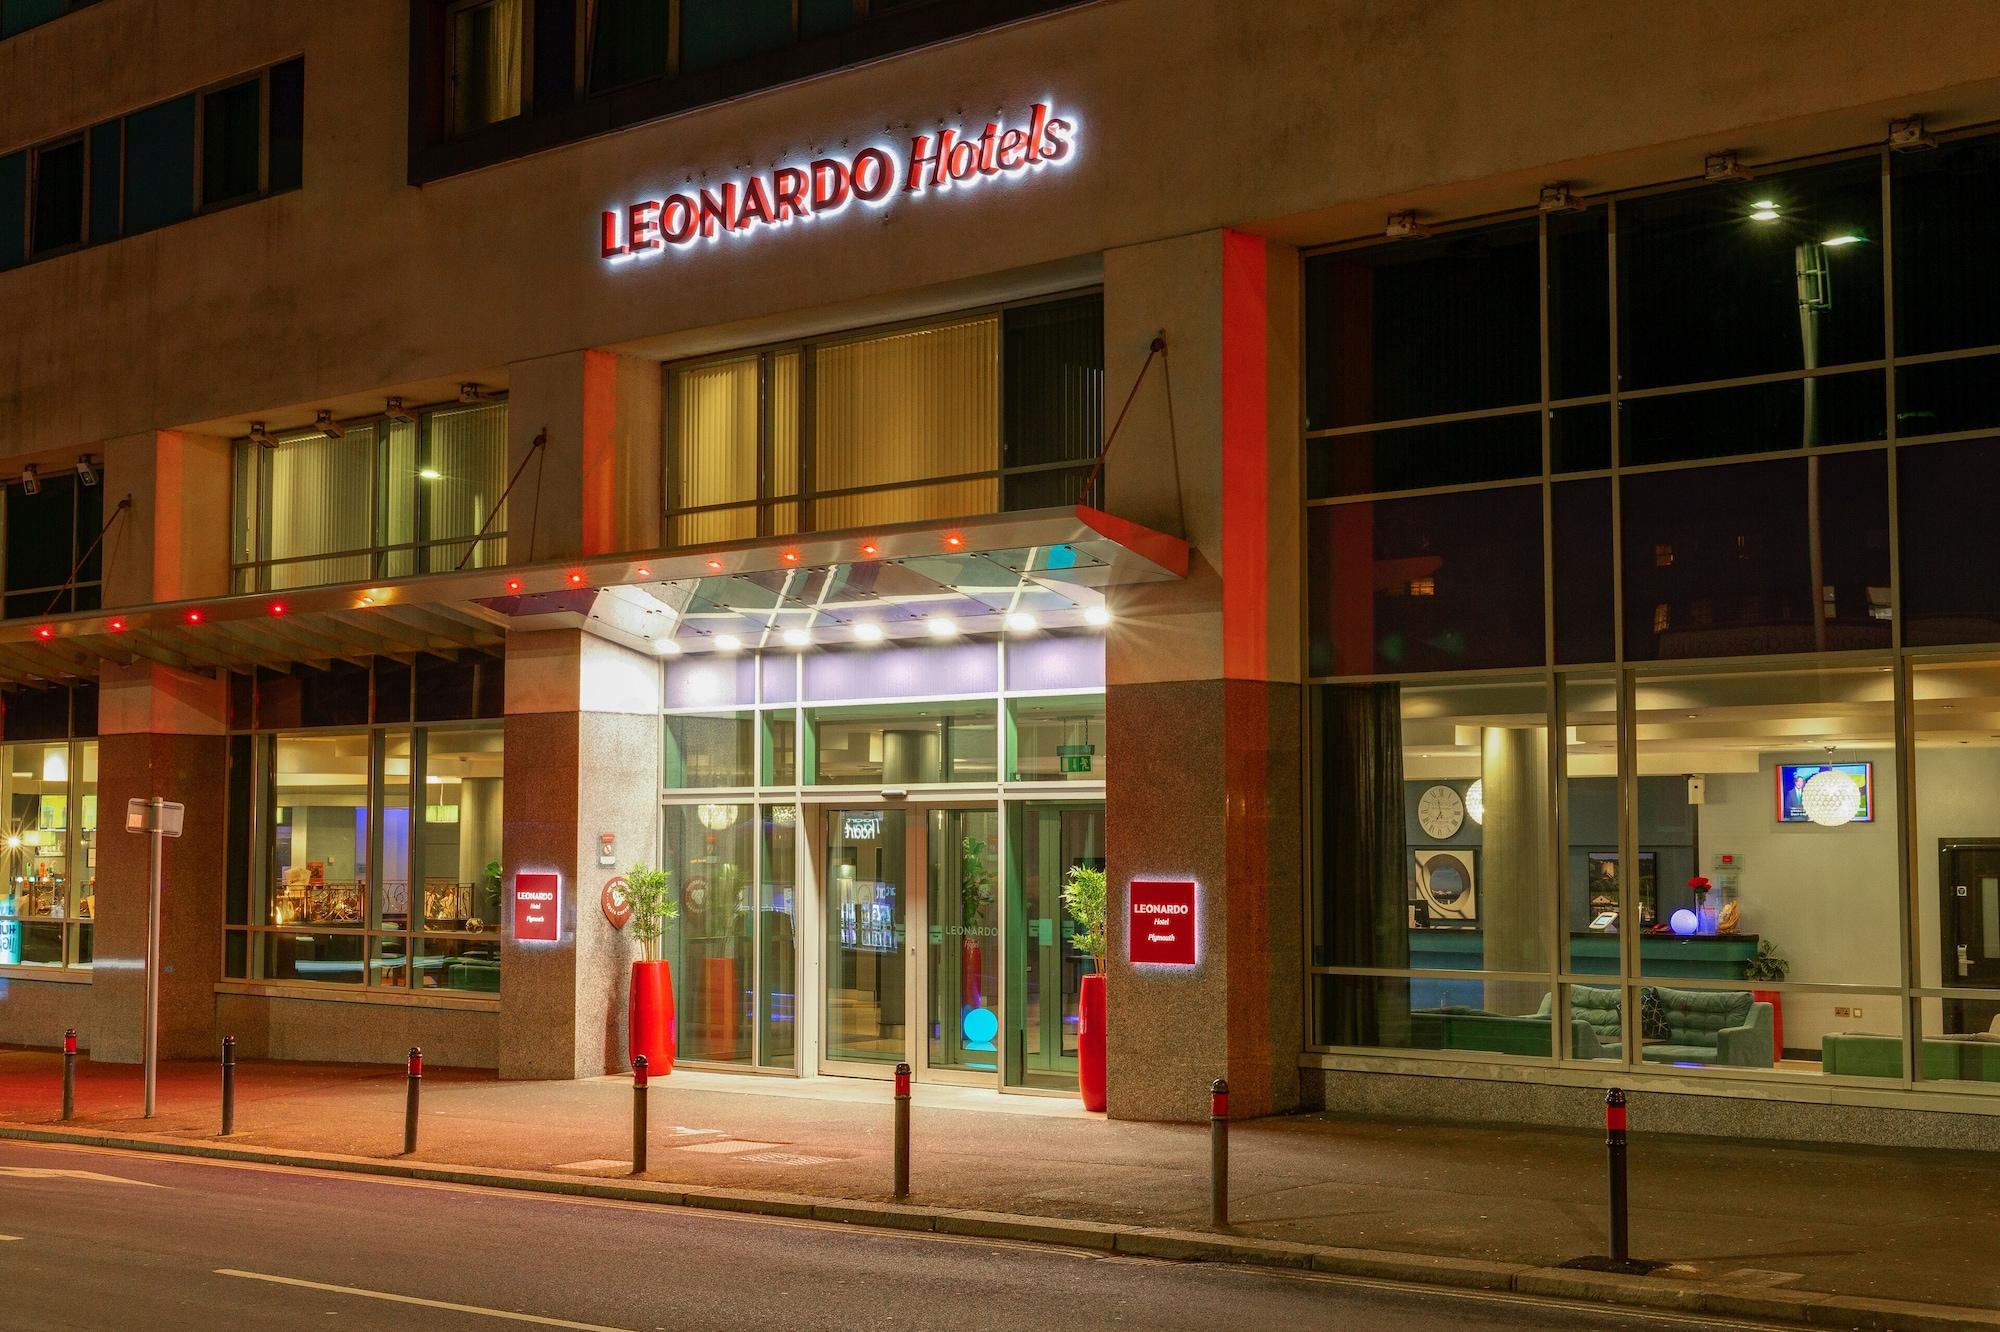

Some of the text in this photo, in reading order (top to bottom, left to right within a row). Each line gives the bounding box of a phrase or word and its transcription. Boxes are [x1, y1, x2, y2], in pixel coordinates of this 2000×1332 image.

[601, 102, 1072, 260] LEONARDO Hotels
[517, 892, 553, 900] LEONARDO
[1134, 903, 1189, 914] LEONARDO
[1153, 918, 1170, 926] Hotel
[945, 925, 998, 937] LEONARDO
[1148, 933, 1175, 942] Plymouth
